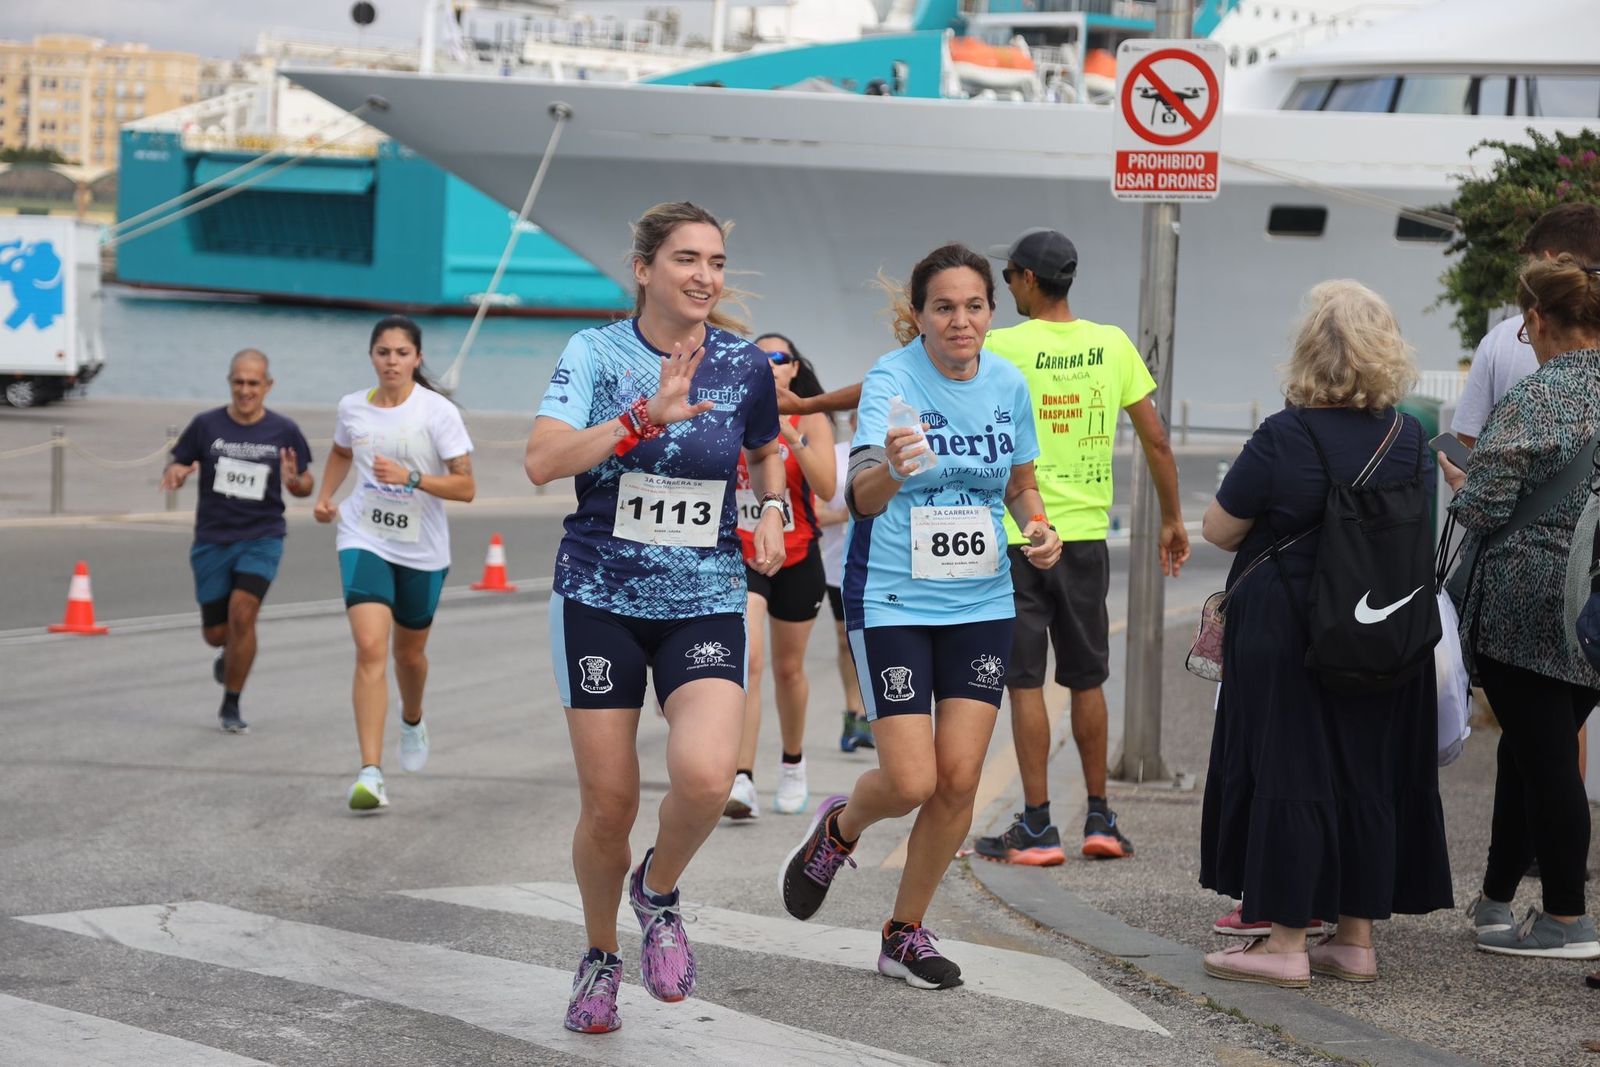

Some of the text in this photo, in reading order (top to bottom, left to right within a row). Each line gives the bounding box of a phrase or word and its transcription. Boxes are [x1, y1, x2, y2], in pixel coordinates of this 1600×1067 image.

[1128, 153, 1205, 169] PROHIBIDO
[1116, 172, 1216, 189] USAR DRONES
[1035, 347, 1104, 370] CARRERA 5K
[697, 385, 742, 405] nerja
[1039, 408, 1083, 420] TRASPLANTE
[1051, 422, 1070, 434] VIDA
[925, 425, 1015, 464] nerja
[226, 471, 255, 487] 901
[939, 466, 1008, 479] ATLETISMO
[371, 508, 409, 529] 868
[627, 496, 712, 526] 1113
[931, 531, 986, 557] 866
